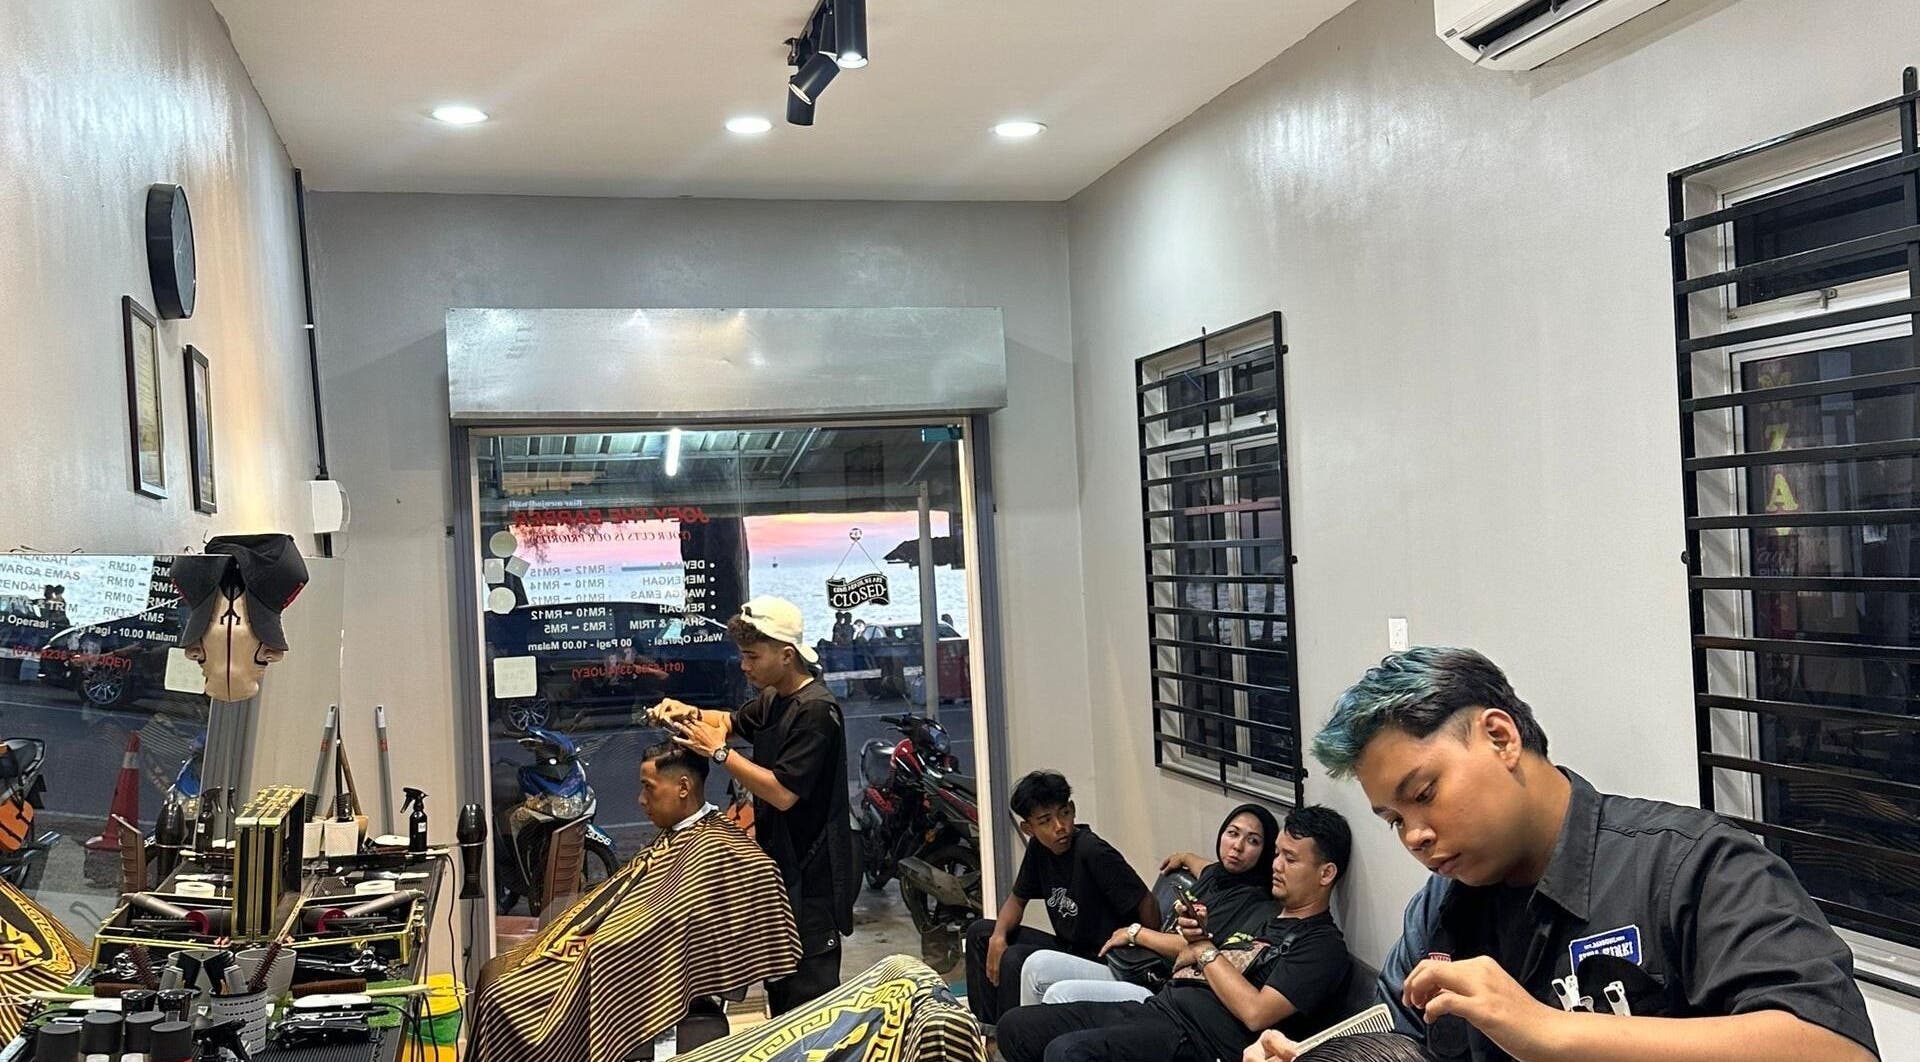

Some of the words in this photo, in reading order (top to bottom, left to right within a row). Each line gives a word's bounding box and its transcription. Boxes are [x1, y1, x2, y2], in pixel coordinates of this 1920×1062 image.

[45, 568, 81, 580] EMAS
[107, 576, 135, 588] RM10
[105, 591, 132, 603] RM10
[833, 583, 884, 607] CLOSED
[138, 611, 164, 623] RM5
[7, 614, 49, 629] Operasi
[88, 624, 111, 637] Pagi
[119, 628, 143, 639] 10.00
[146, 631, 178, 642] Malam
